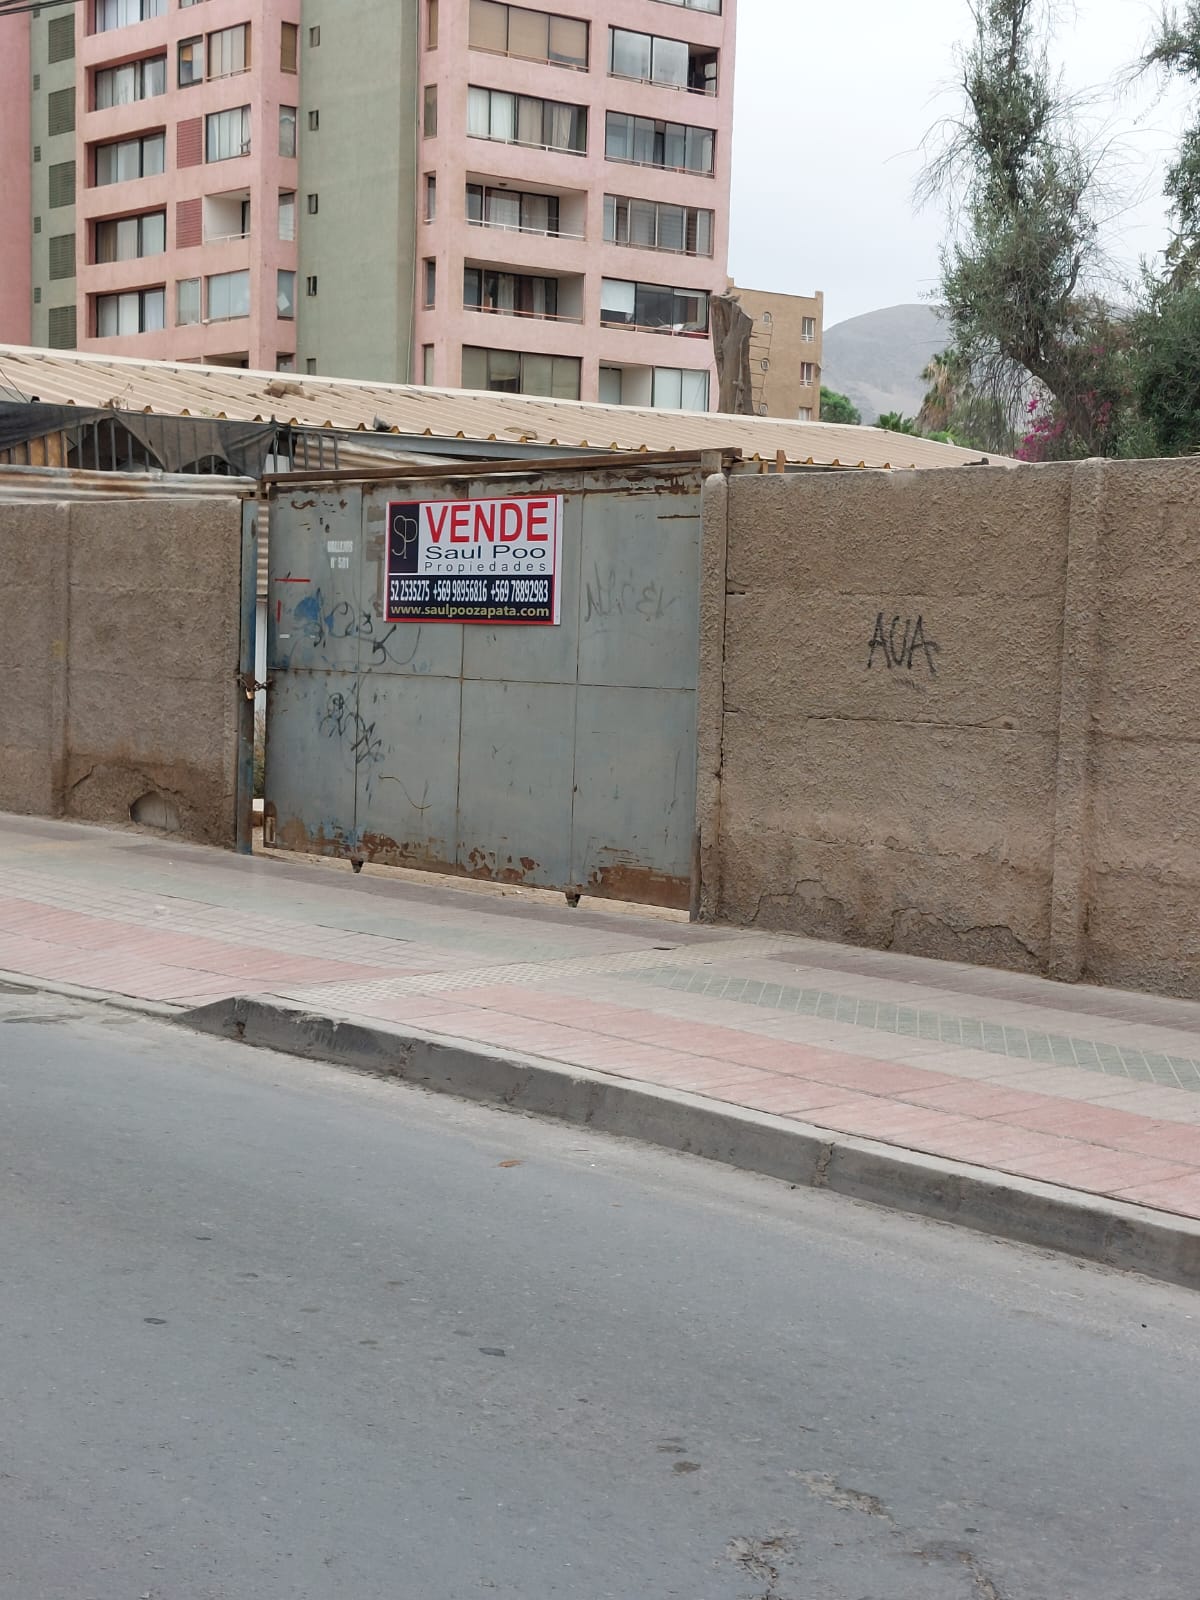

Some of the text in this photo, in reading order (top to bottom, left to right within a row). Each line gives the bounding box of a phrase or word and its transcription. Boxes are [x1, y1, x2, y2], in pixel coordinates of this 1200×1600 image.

[425, 501, 549, 543] VENDE
[425, 545, 546, 559] Saul Poo
[424, 560, 546, 573] Propiedades
[390, 580, 549, 603] 52 2535275 +569 98956816 +569 78892983
[390, 603, 550, 619] www.saulpoozapata.com
